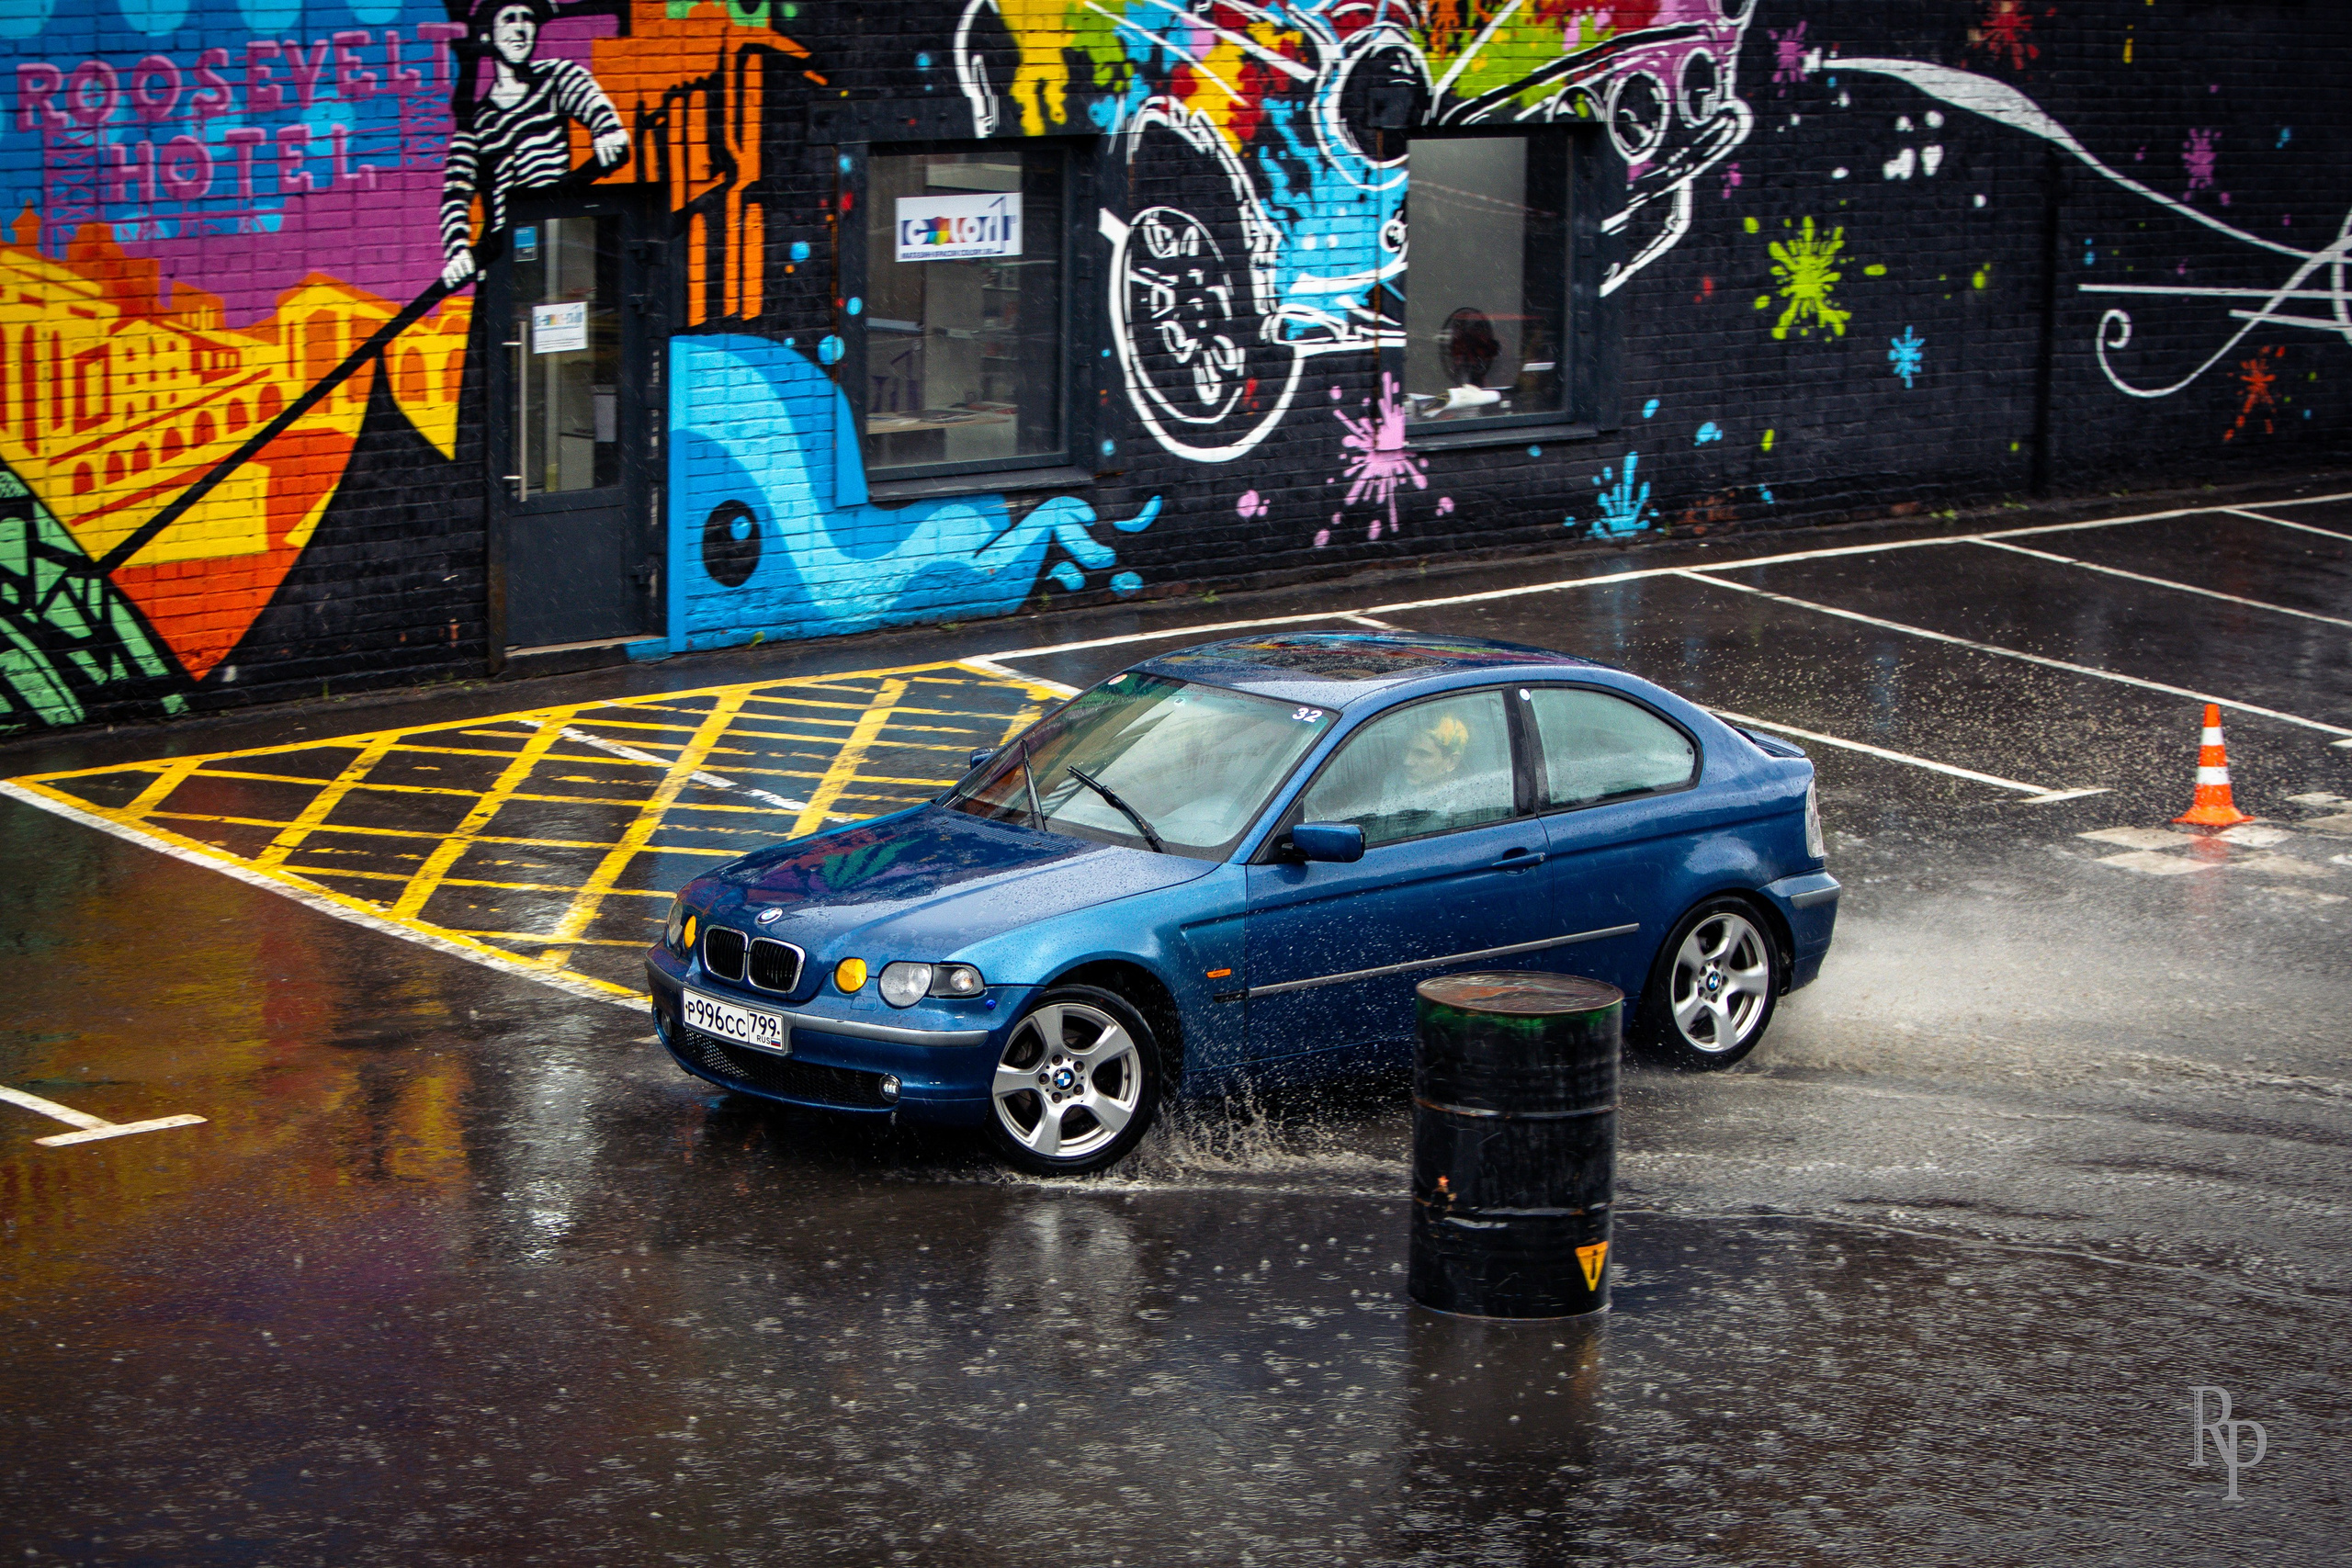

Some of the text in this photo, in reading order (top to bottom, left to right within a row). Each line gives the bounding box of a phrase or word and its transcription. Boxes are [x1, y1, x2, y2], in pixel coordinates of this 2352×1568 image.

[16, 21, 469, 133] ROOSEVELT
[109, 123, 377, 202] HOTEL
[1292, 707, 1323, 723] 32
[749, 1012, 777, 1037] 799
[756, 1034, 771, 1045] RUS
